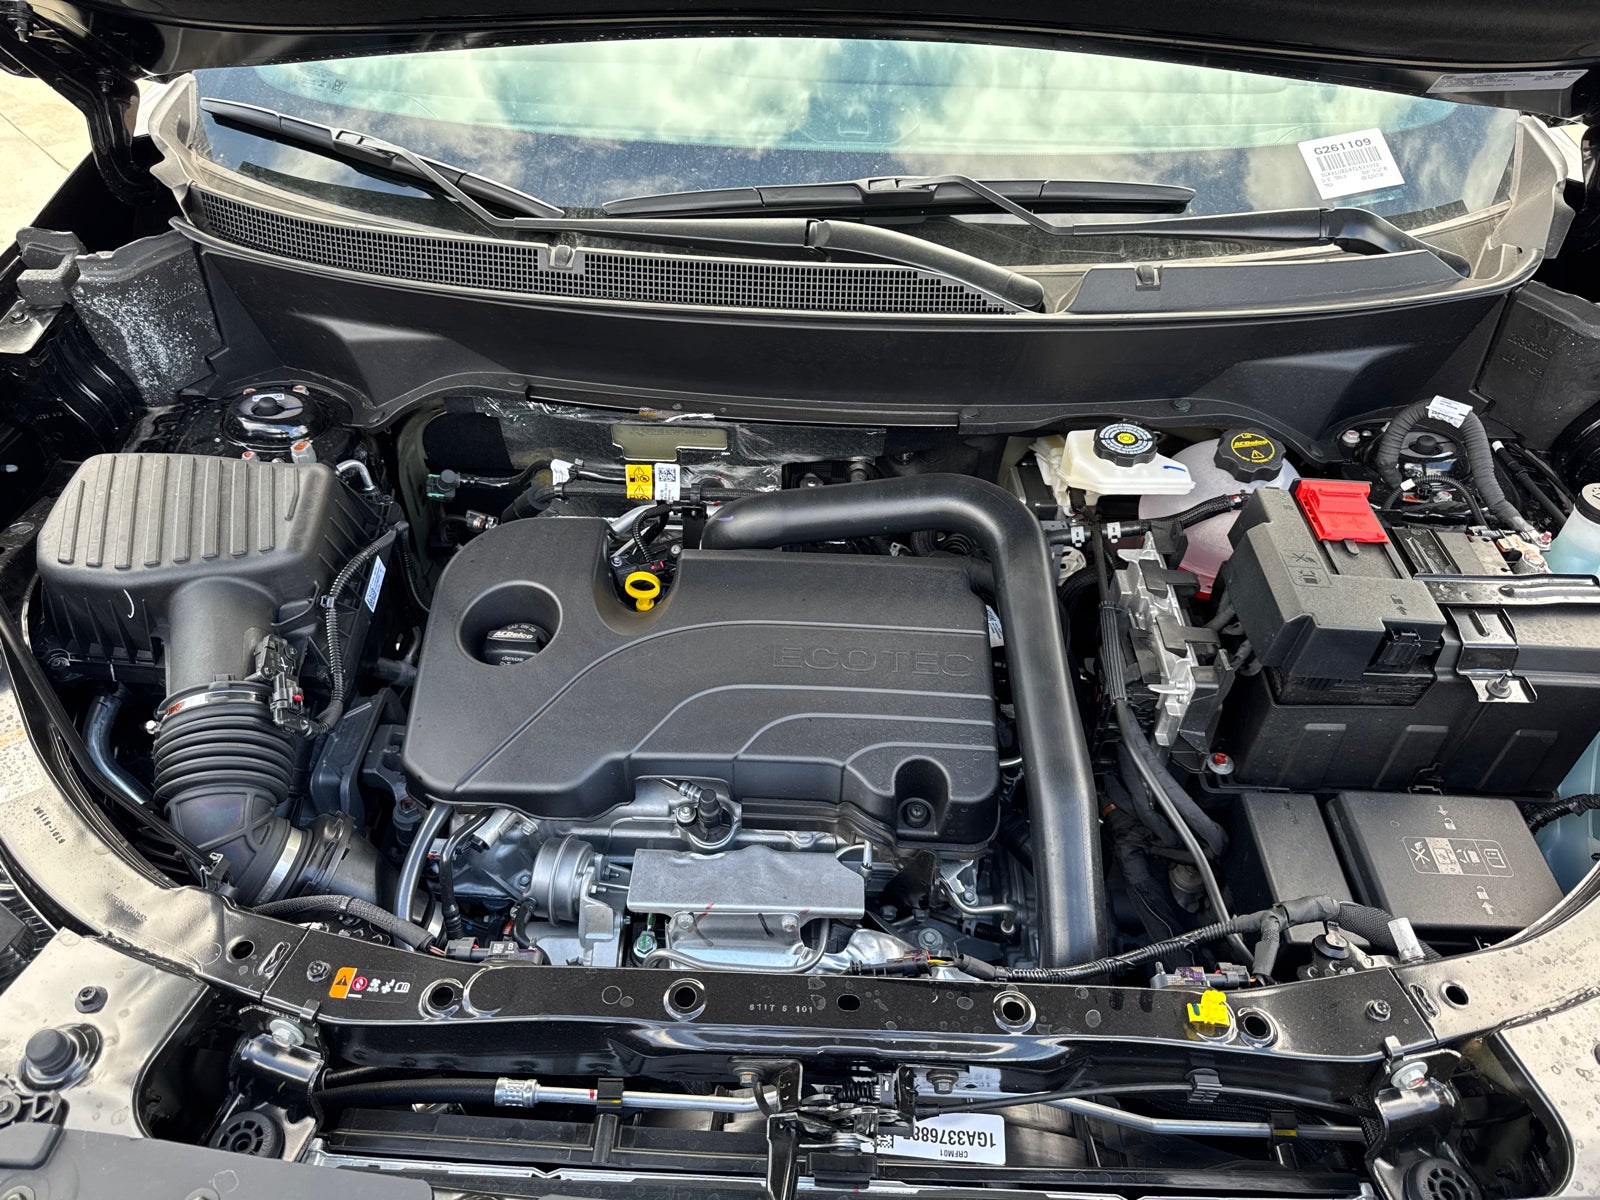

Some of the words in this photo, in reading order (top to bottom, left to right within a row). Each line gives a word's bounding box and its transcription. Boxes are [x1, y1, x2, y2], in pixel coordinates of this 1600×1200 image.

[1314, 138, 1371, 155] G261109
[492, 630, 533, 639] ACDelco
[773, 646, 974, 677] ECOTEC
[795, 1005, 813, 1014] 101
[903, 1126, 997, 1148] 1GA337688
[940, 1149, 968, 1158] CRFM01
